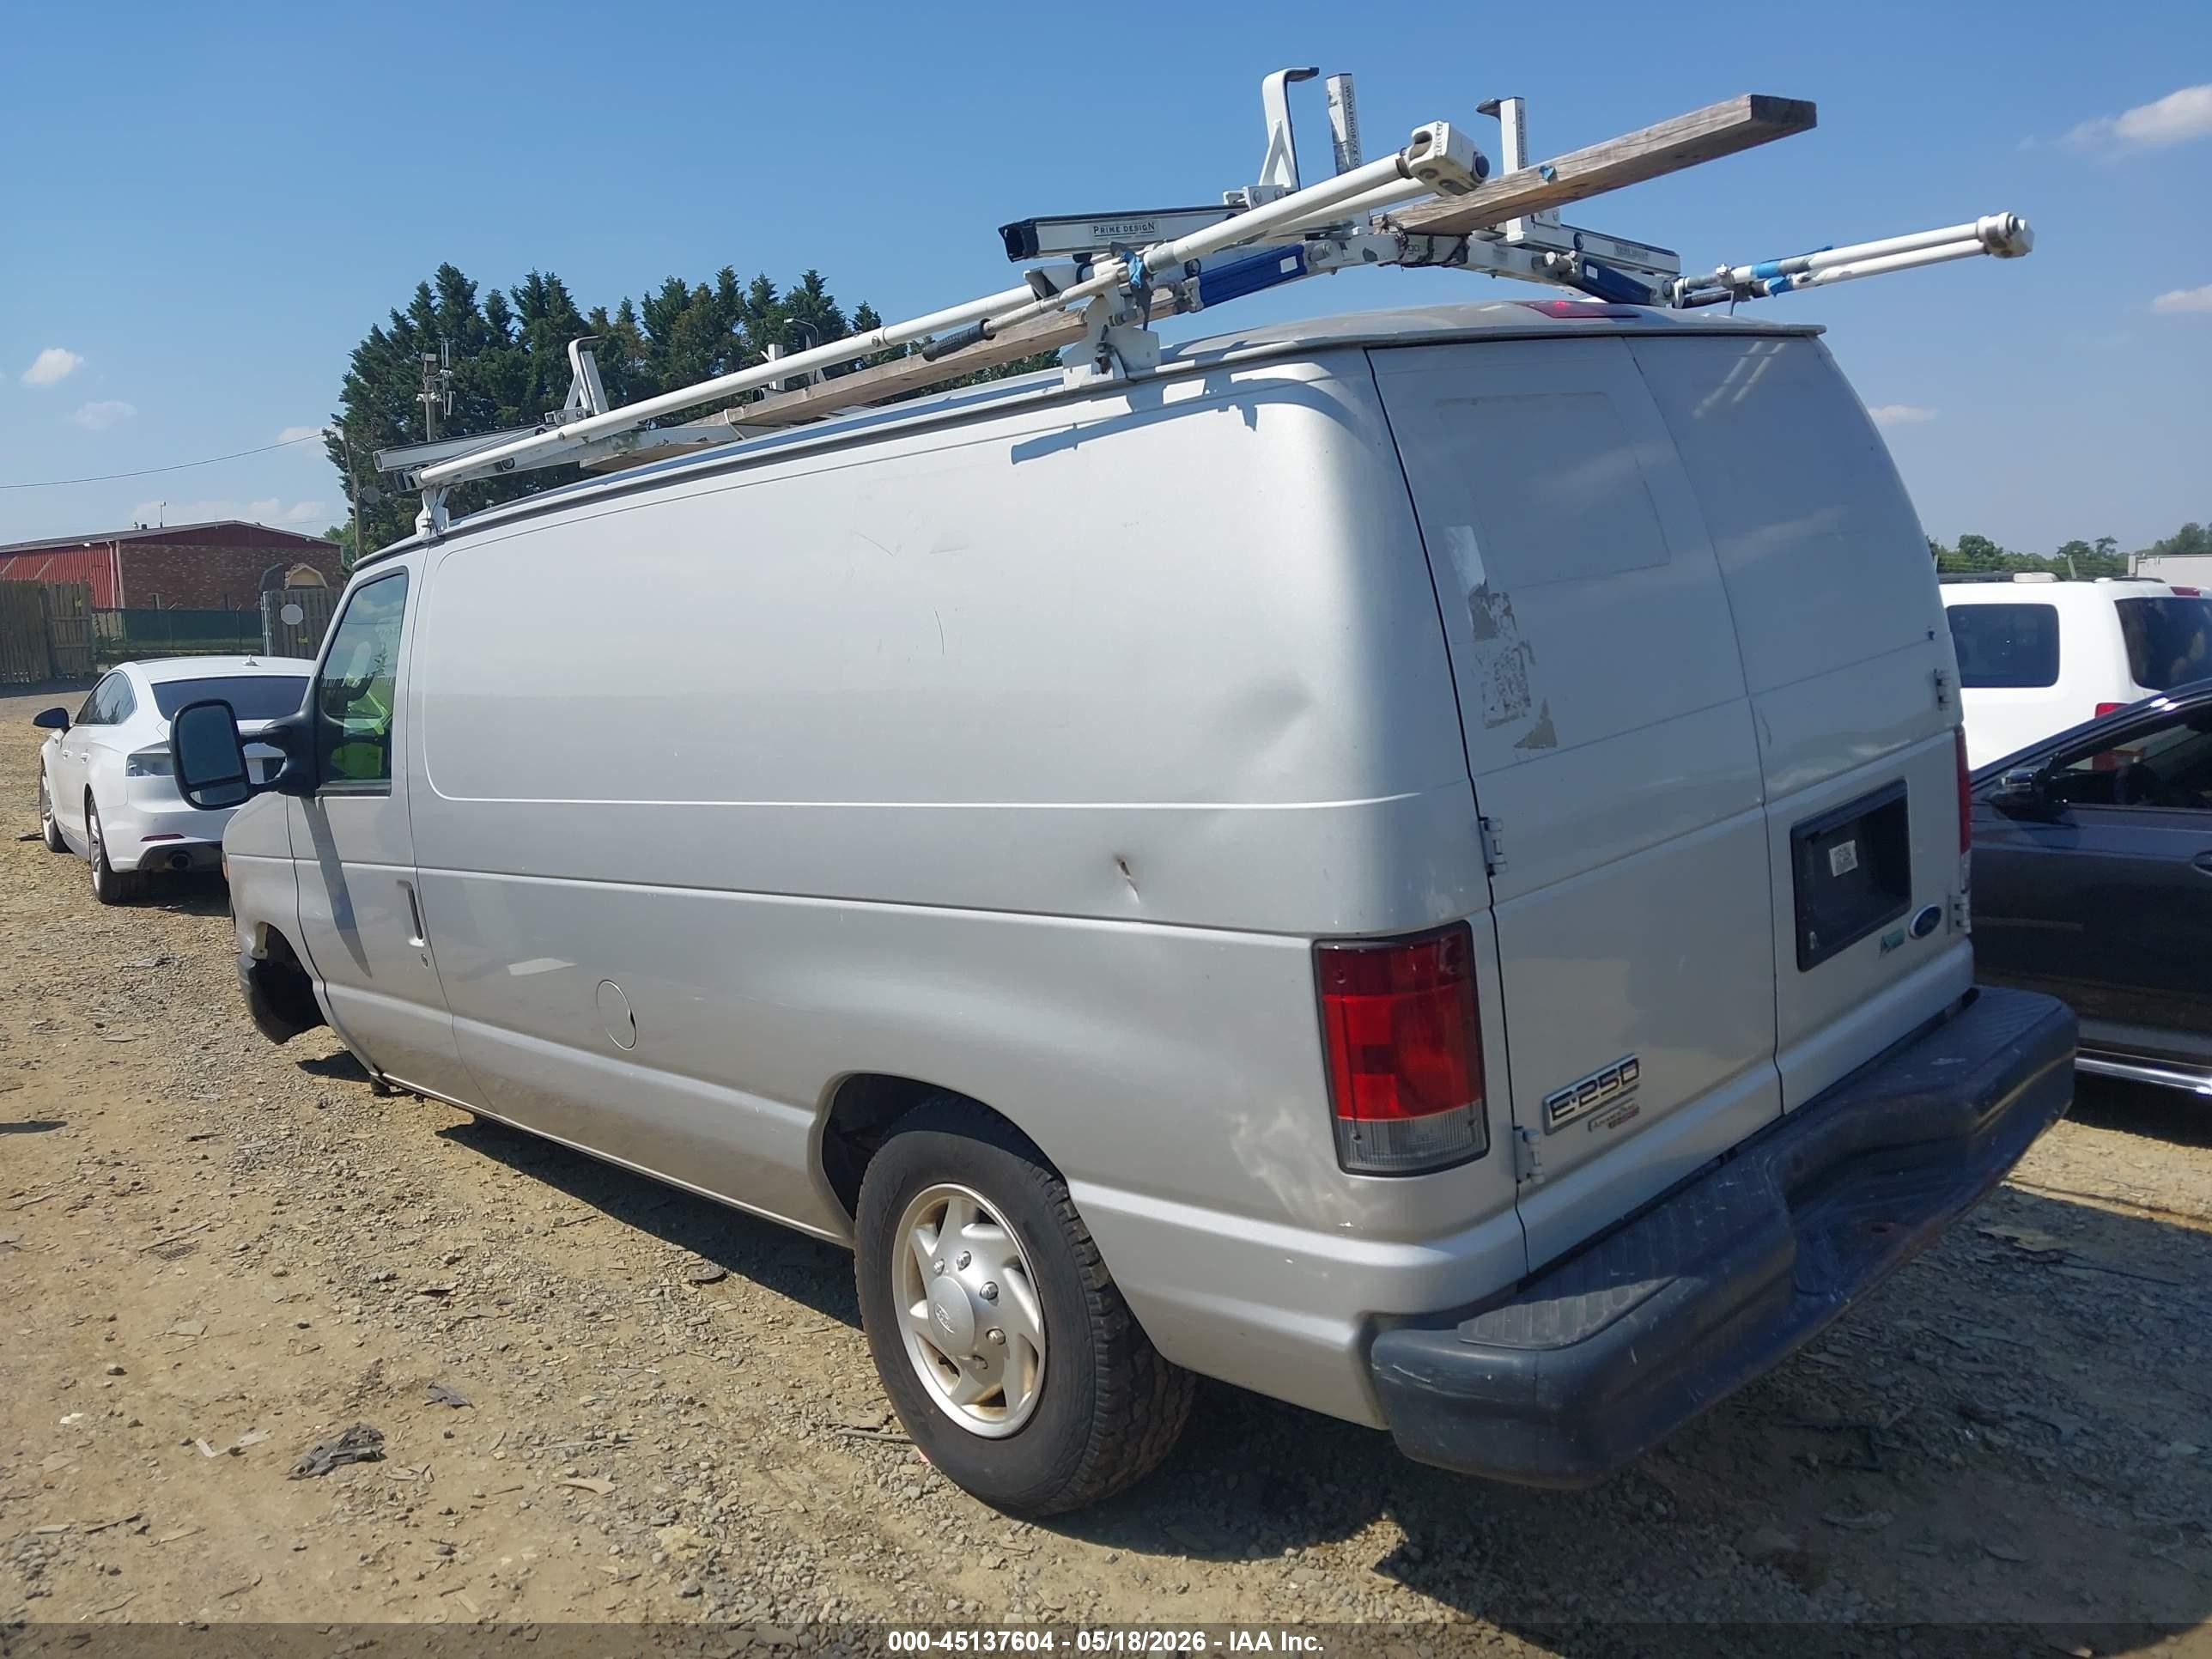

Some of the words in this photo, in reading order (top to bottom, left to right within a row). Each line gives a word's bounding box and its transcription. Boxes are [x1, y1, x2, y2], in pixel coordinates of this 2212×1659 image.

[1346, 85, 1360, 170] WWW.ERGORACK.CO
[1093, 225, 1121, 234] PRIME
[1123, 222, 1155, 233] DESIGN
